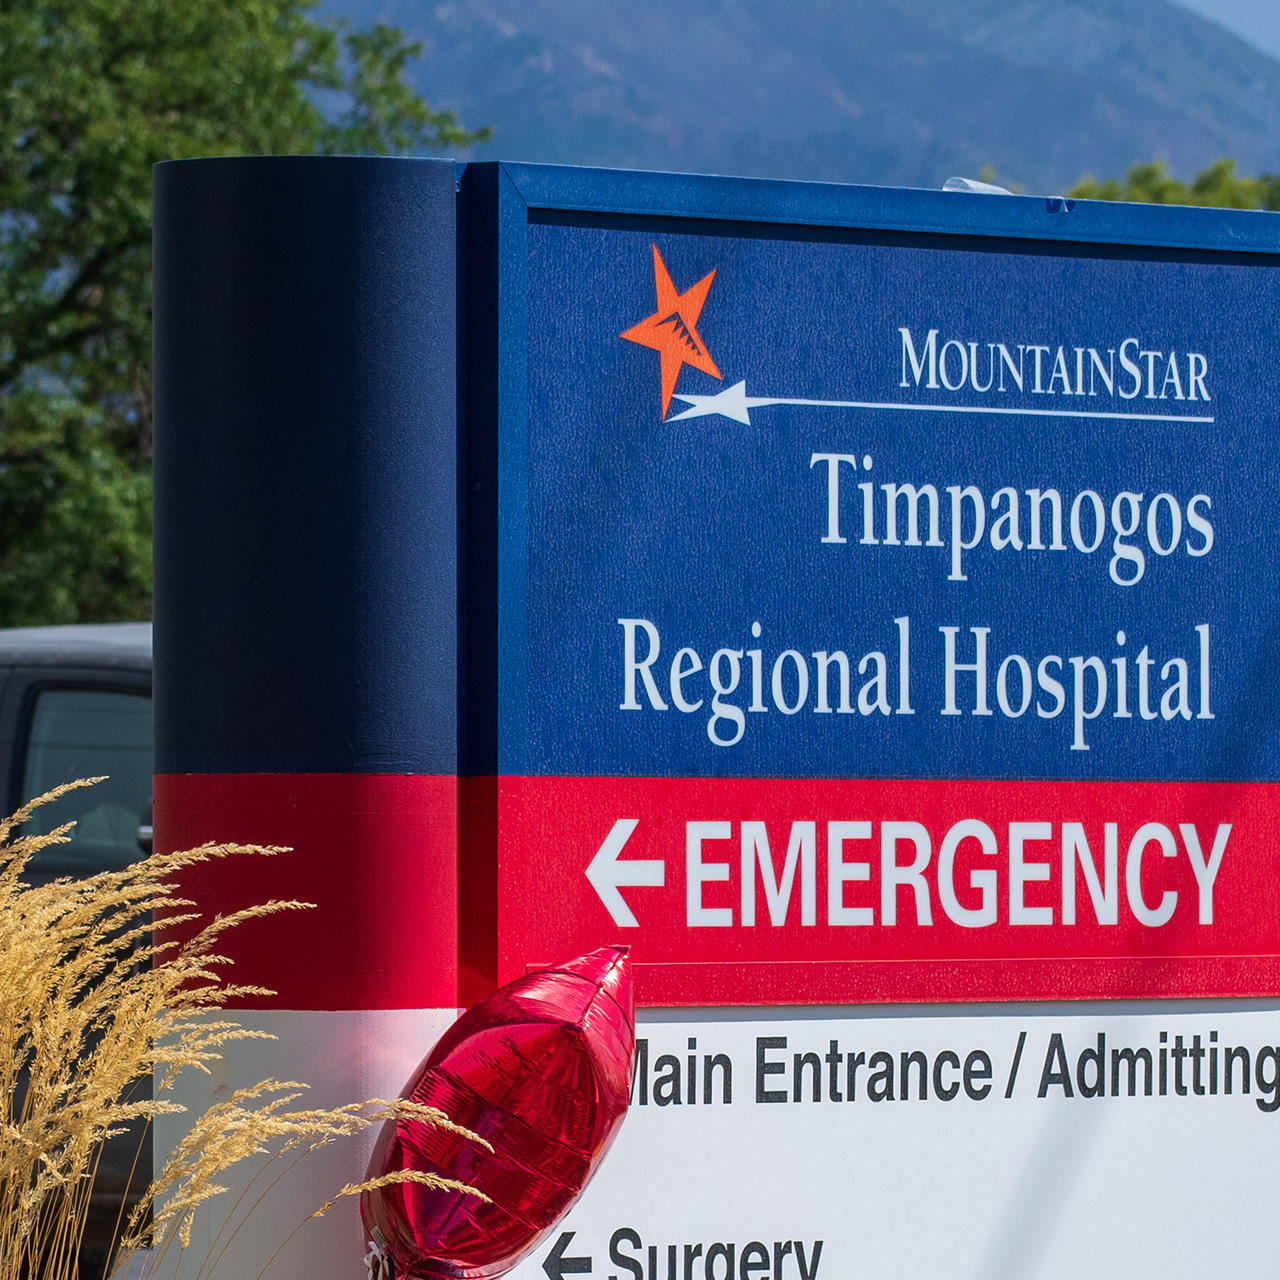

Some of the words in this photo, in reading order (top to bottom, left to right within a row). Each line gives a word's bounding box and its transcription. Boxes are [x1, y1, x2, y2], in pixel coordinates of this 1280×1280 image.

[810, 453, 1214, 586] Timpanogos
[618, 617, 915, 747] Regional
[939, 624, 1215, 751] Hospital
[686, 819, 1233, 928] EMERGENCY
[756, 1037, 993, 1104] Entrance
